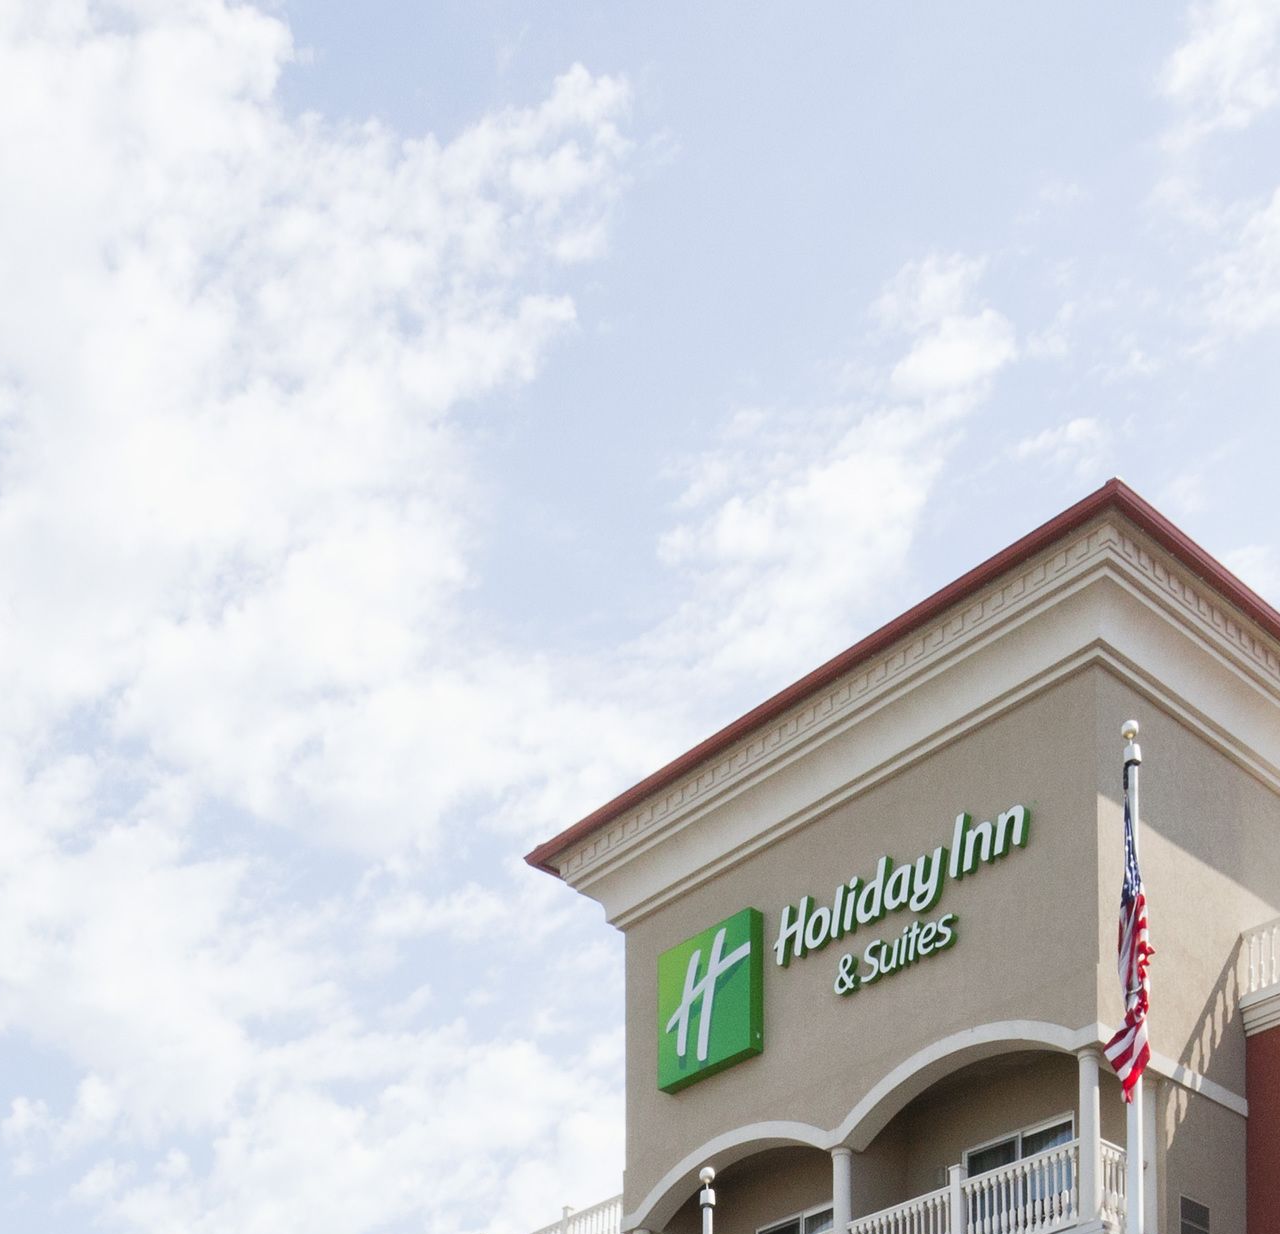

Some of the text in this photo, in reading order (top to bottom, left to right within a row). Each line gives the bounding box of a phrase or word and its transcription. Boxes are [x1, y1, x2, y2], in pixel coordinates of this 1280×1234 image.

[773, 803, 1031, 969] Holiday Inn
[833, 912, 959, 997] & Suites
